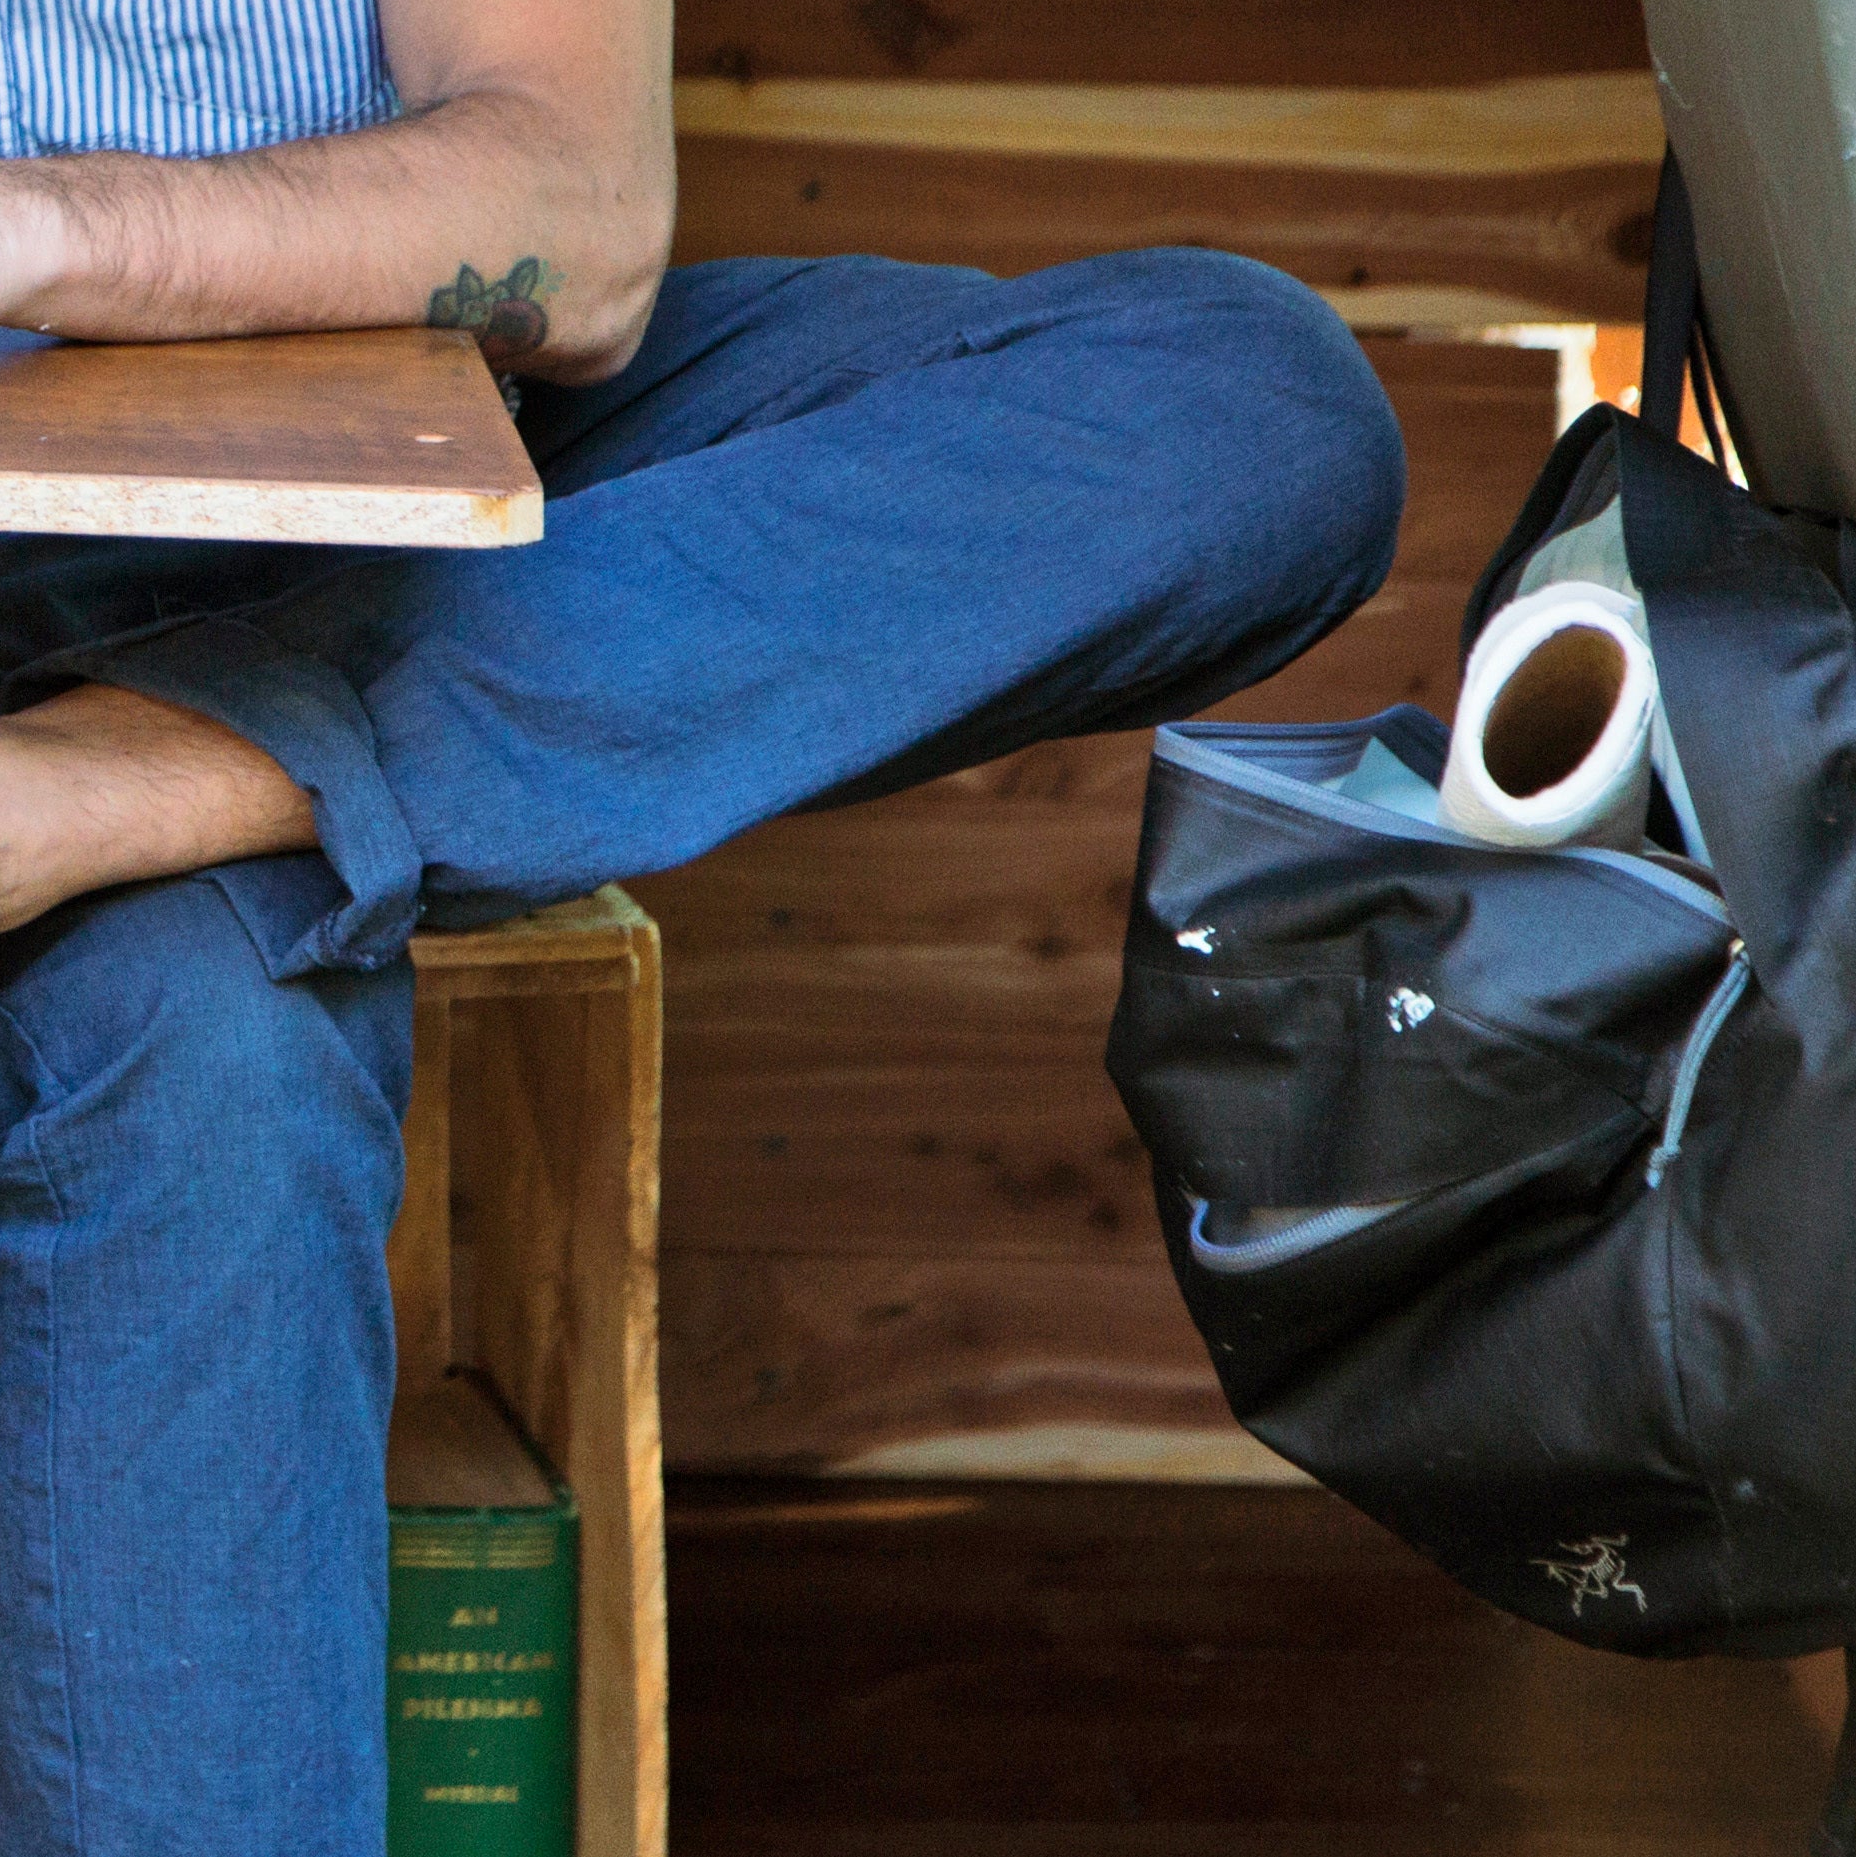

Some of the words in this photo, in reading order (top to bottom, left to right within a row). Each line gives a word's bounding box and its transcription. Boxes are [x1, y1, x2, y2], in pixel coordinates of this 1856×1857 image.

[448, 1607, 499, 1627] AN
[393, 1651, 554, 1674] AMERICAN
[402, 1697, 543, 1721] DILEMMA
